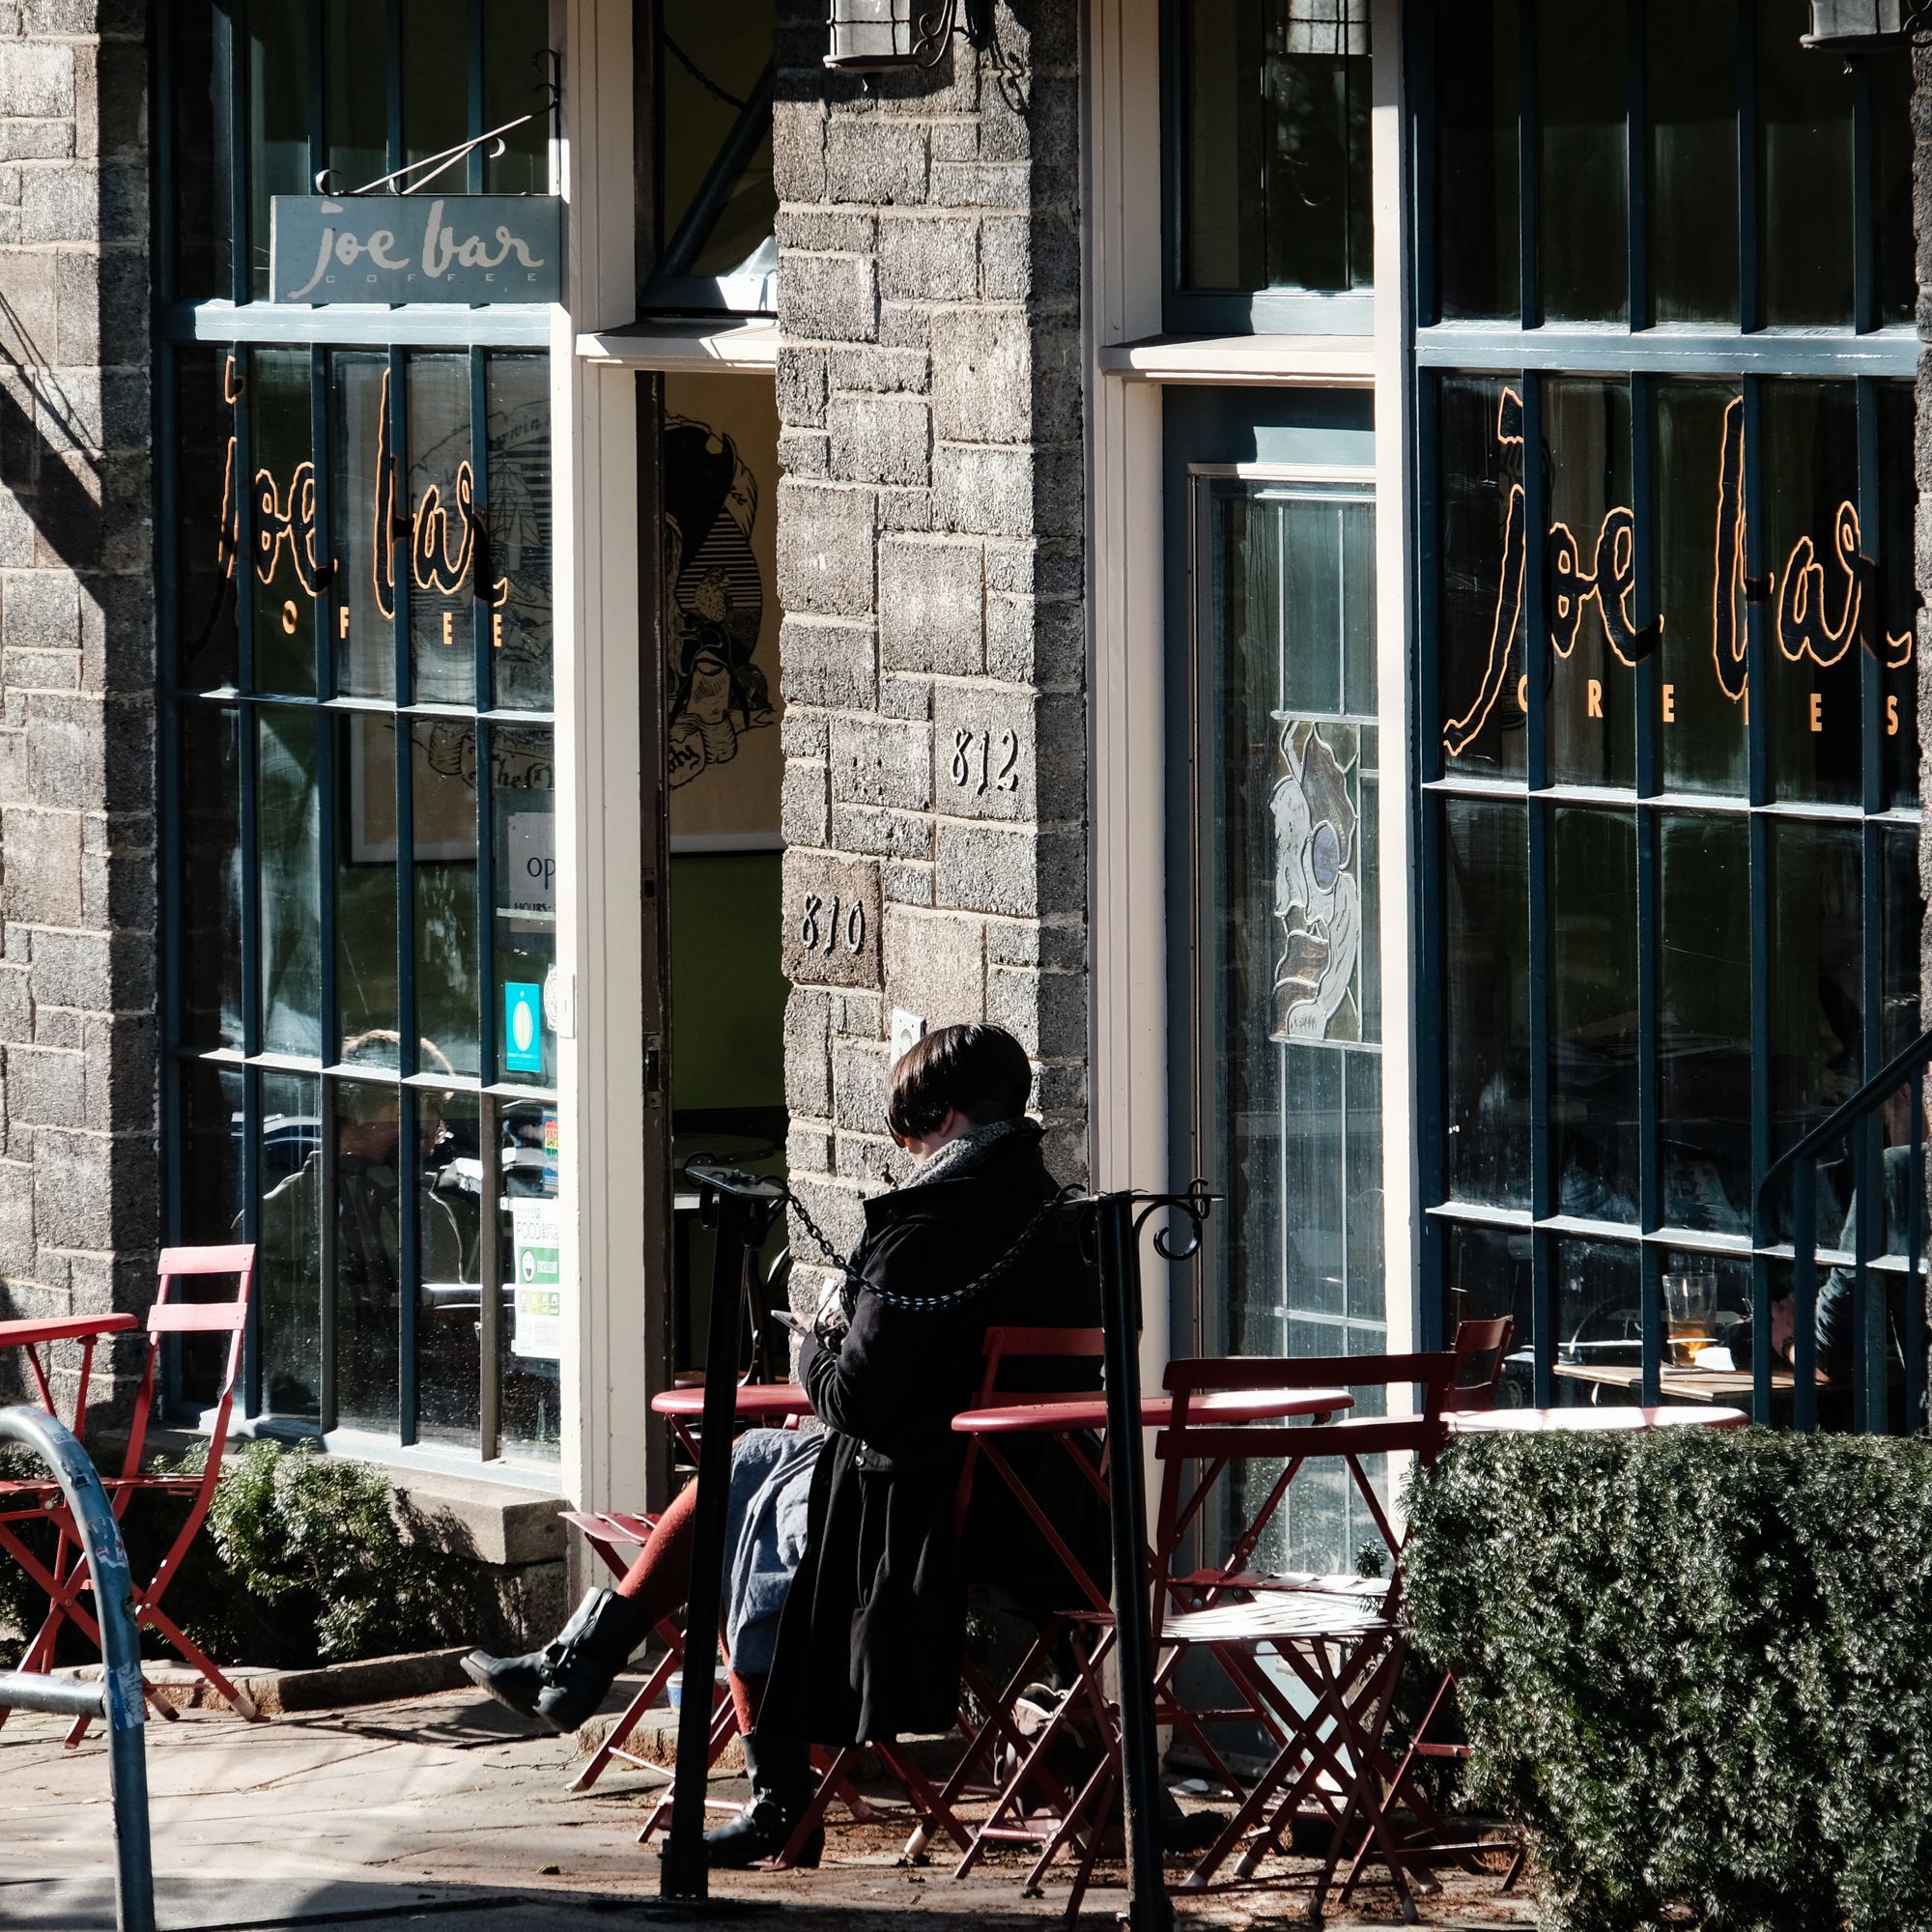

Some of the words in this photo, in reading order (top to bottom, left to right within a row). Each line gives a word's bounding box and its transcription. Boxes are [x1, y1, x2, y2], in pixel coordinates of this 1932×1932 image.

[288, 200, 410, 300] joe
[421, 199, 545, 278] bar
[326, 273, 537, 283] COFFEE
[951, 726, 1019, 796] 812
[801, 891, 867, 956] 810
